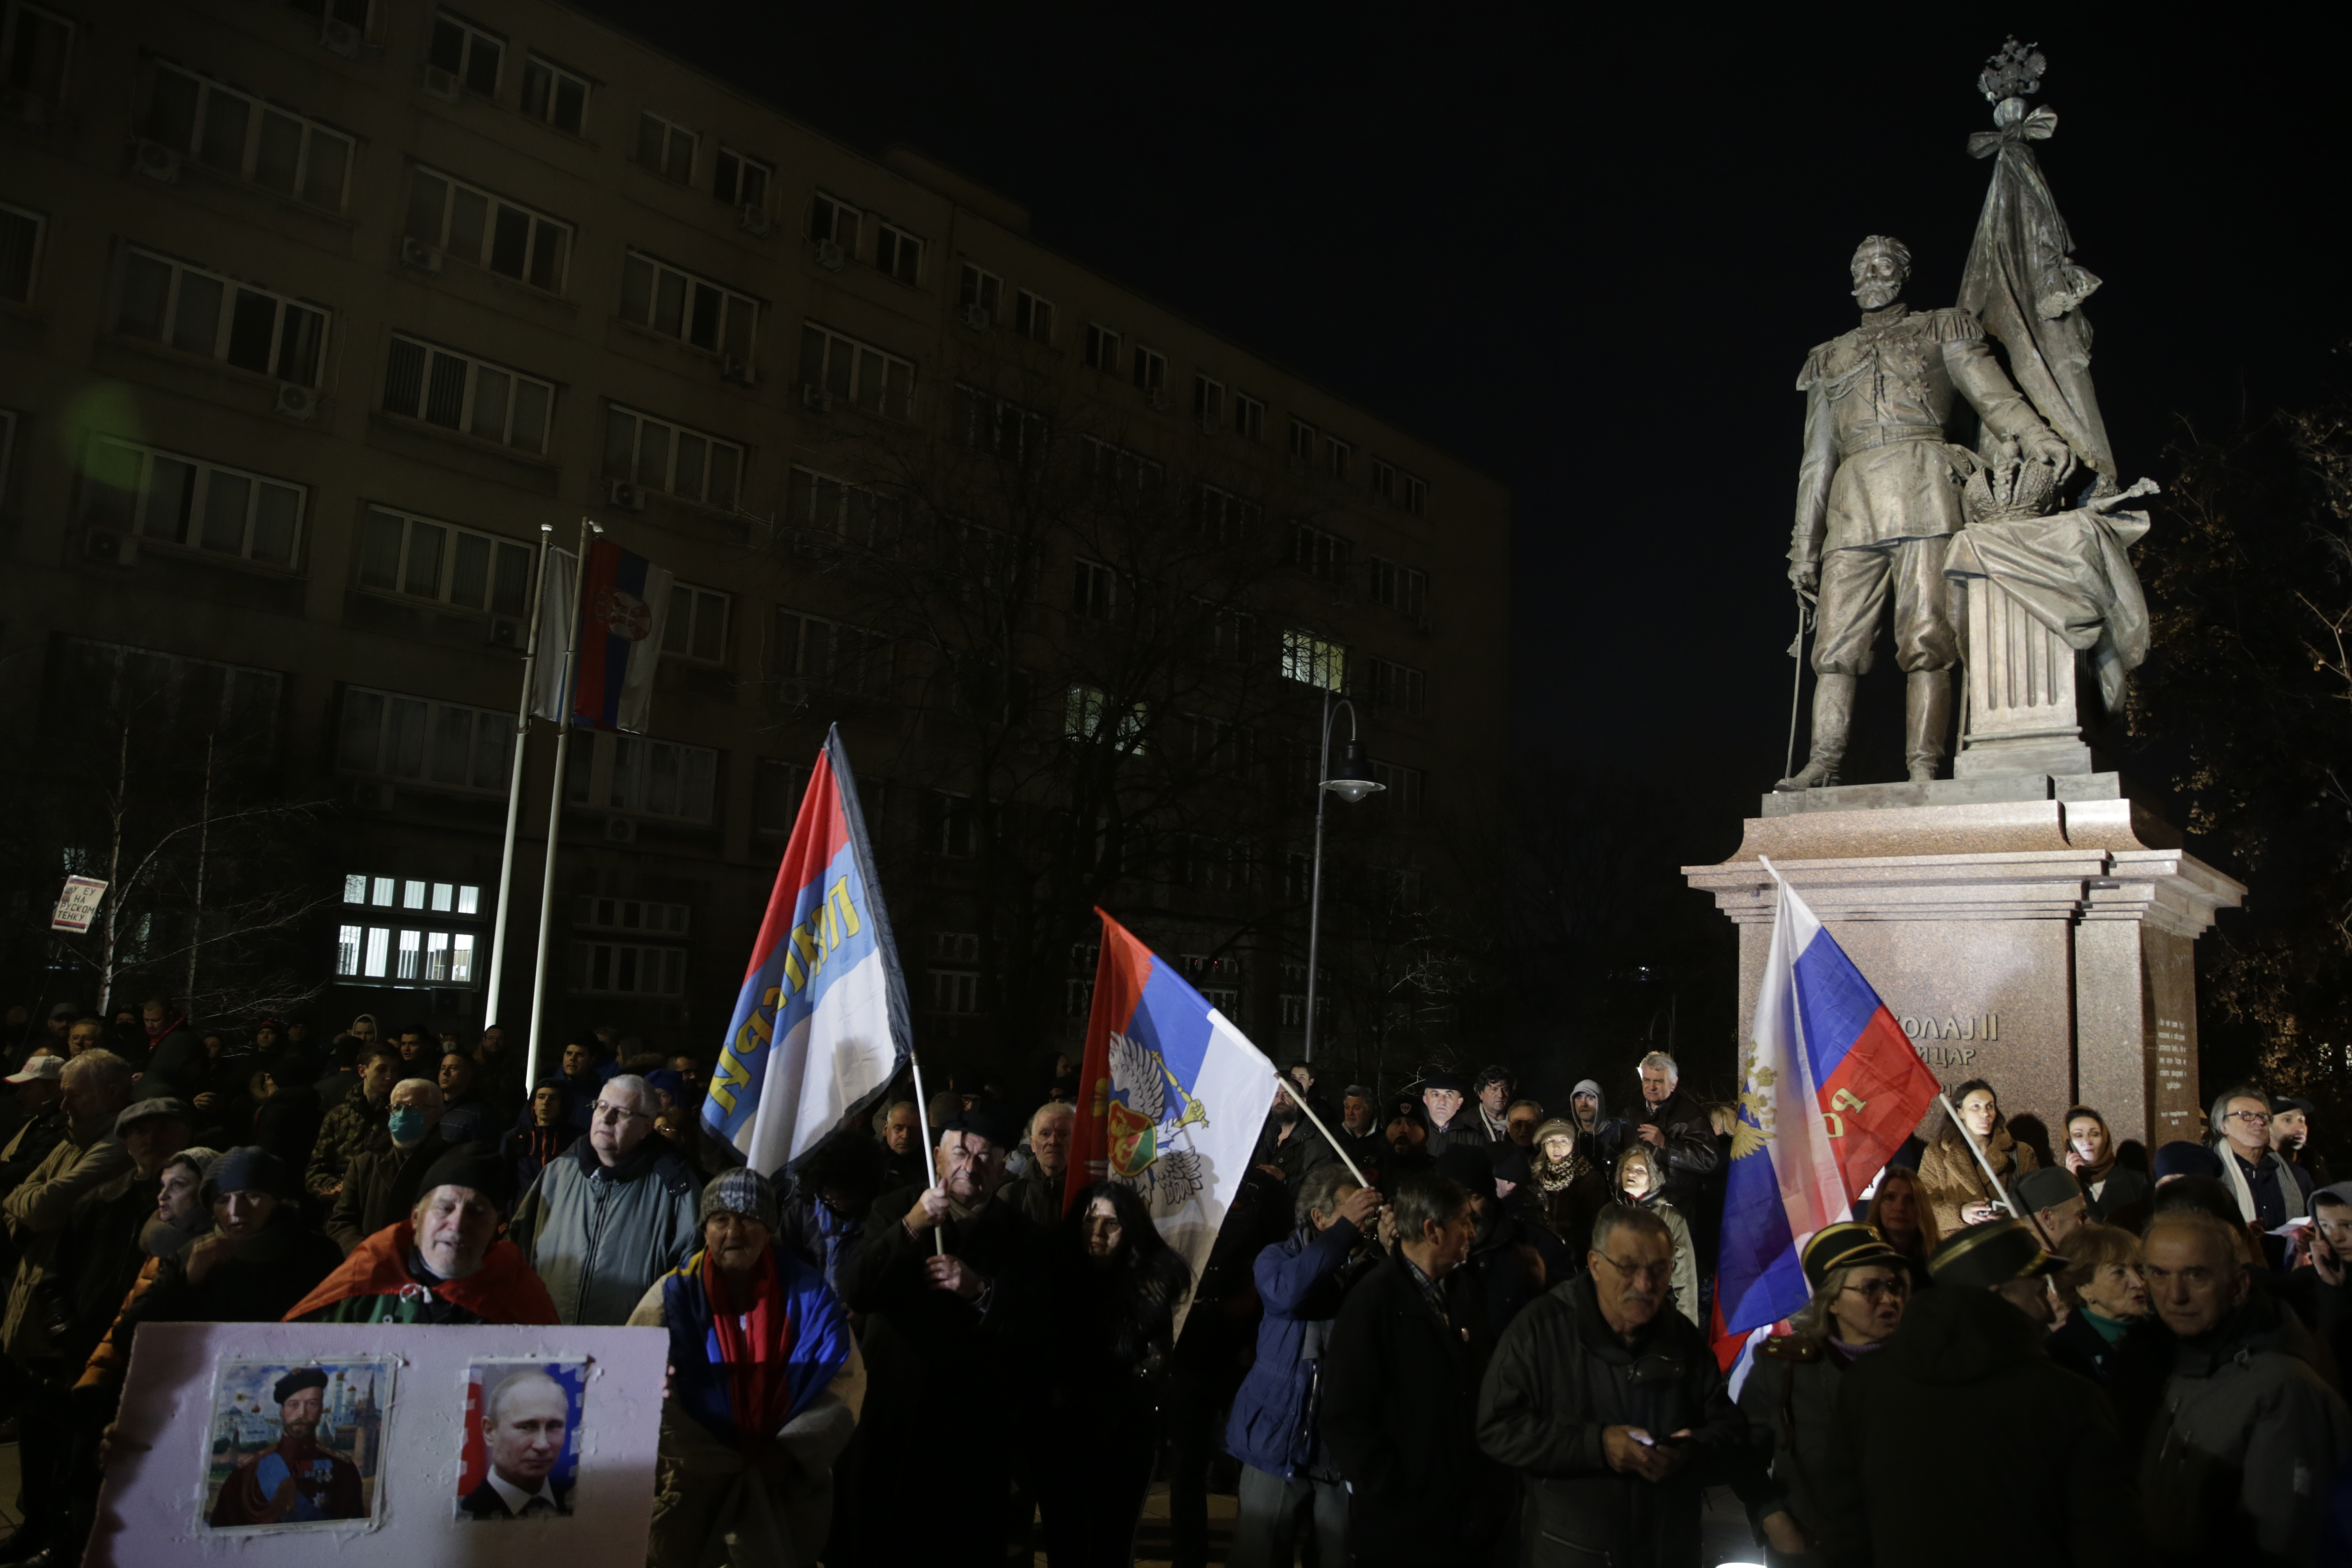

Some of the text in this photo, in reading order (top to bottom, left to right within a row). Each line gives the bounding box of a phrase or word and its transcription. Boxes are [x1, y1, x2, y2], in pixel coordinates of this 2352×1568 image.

[83, 887, 97, 896] ЕУ
[74, 895, 86, 903] НА
[59, 902, 95, 914] РУСКОМ
[58, 911, 85, 921] ТЕНКУ
[1897, 1014, 1998, 1041] ОЛАЈ II
[1937, 1048, 1976, 1068] ЦАР
